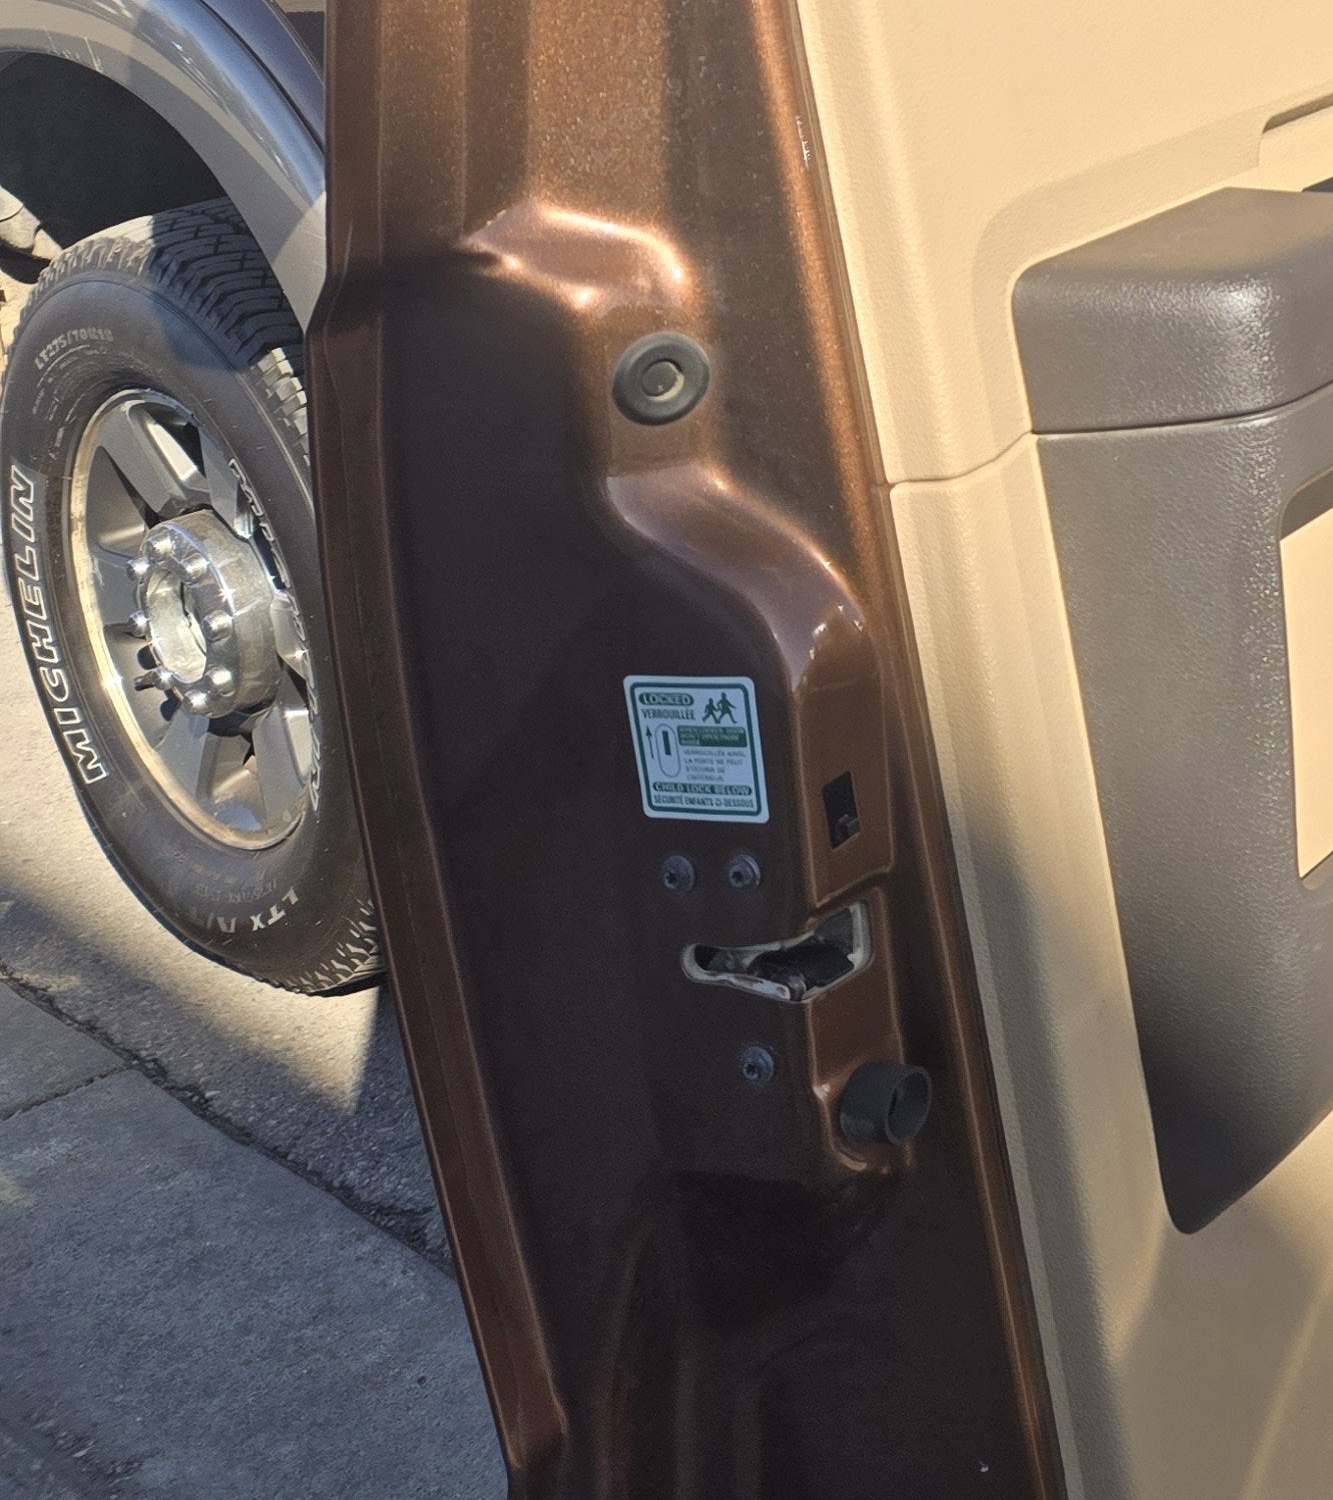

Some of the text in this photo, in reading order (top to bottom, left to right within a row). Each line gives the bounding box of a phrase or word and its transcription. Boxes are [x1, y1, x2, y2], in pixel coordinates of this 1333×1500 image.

[10, 464, 108, 785] MICHELIN
[643, 694, 691, 705] LOCKED
[655, 782, 750, 796] CHILD LOCK BELOW
[250, 886, 299, 932] LTX
